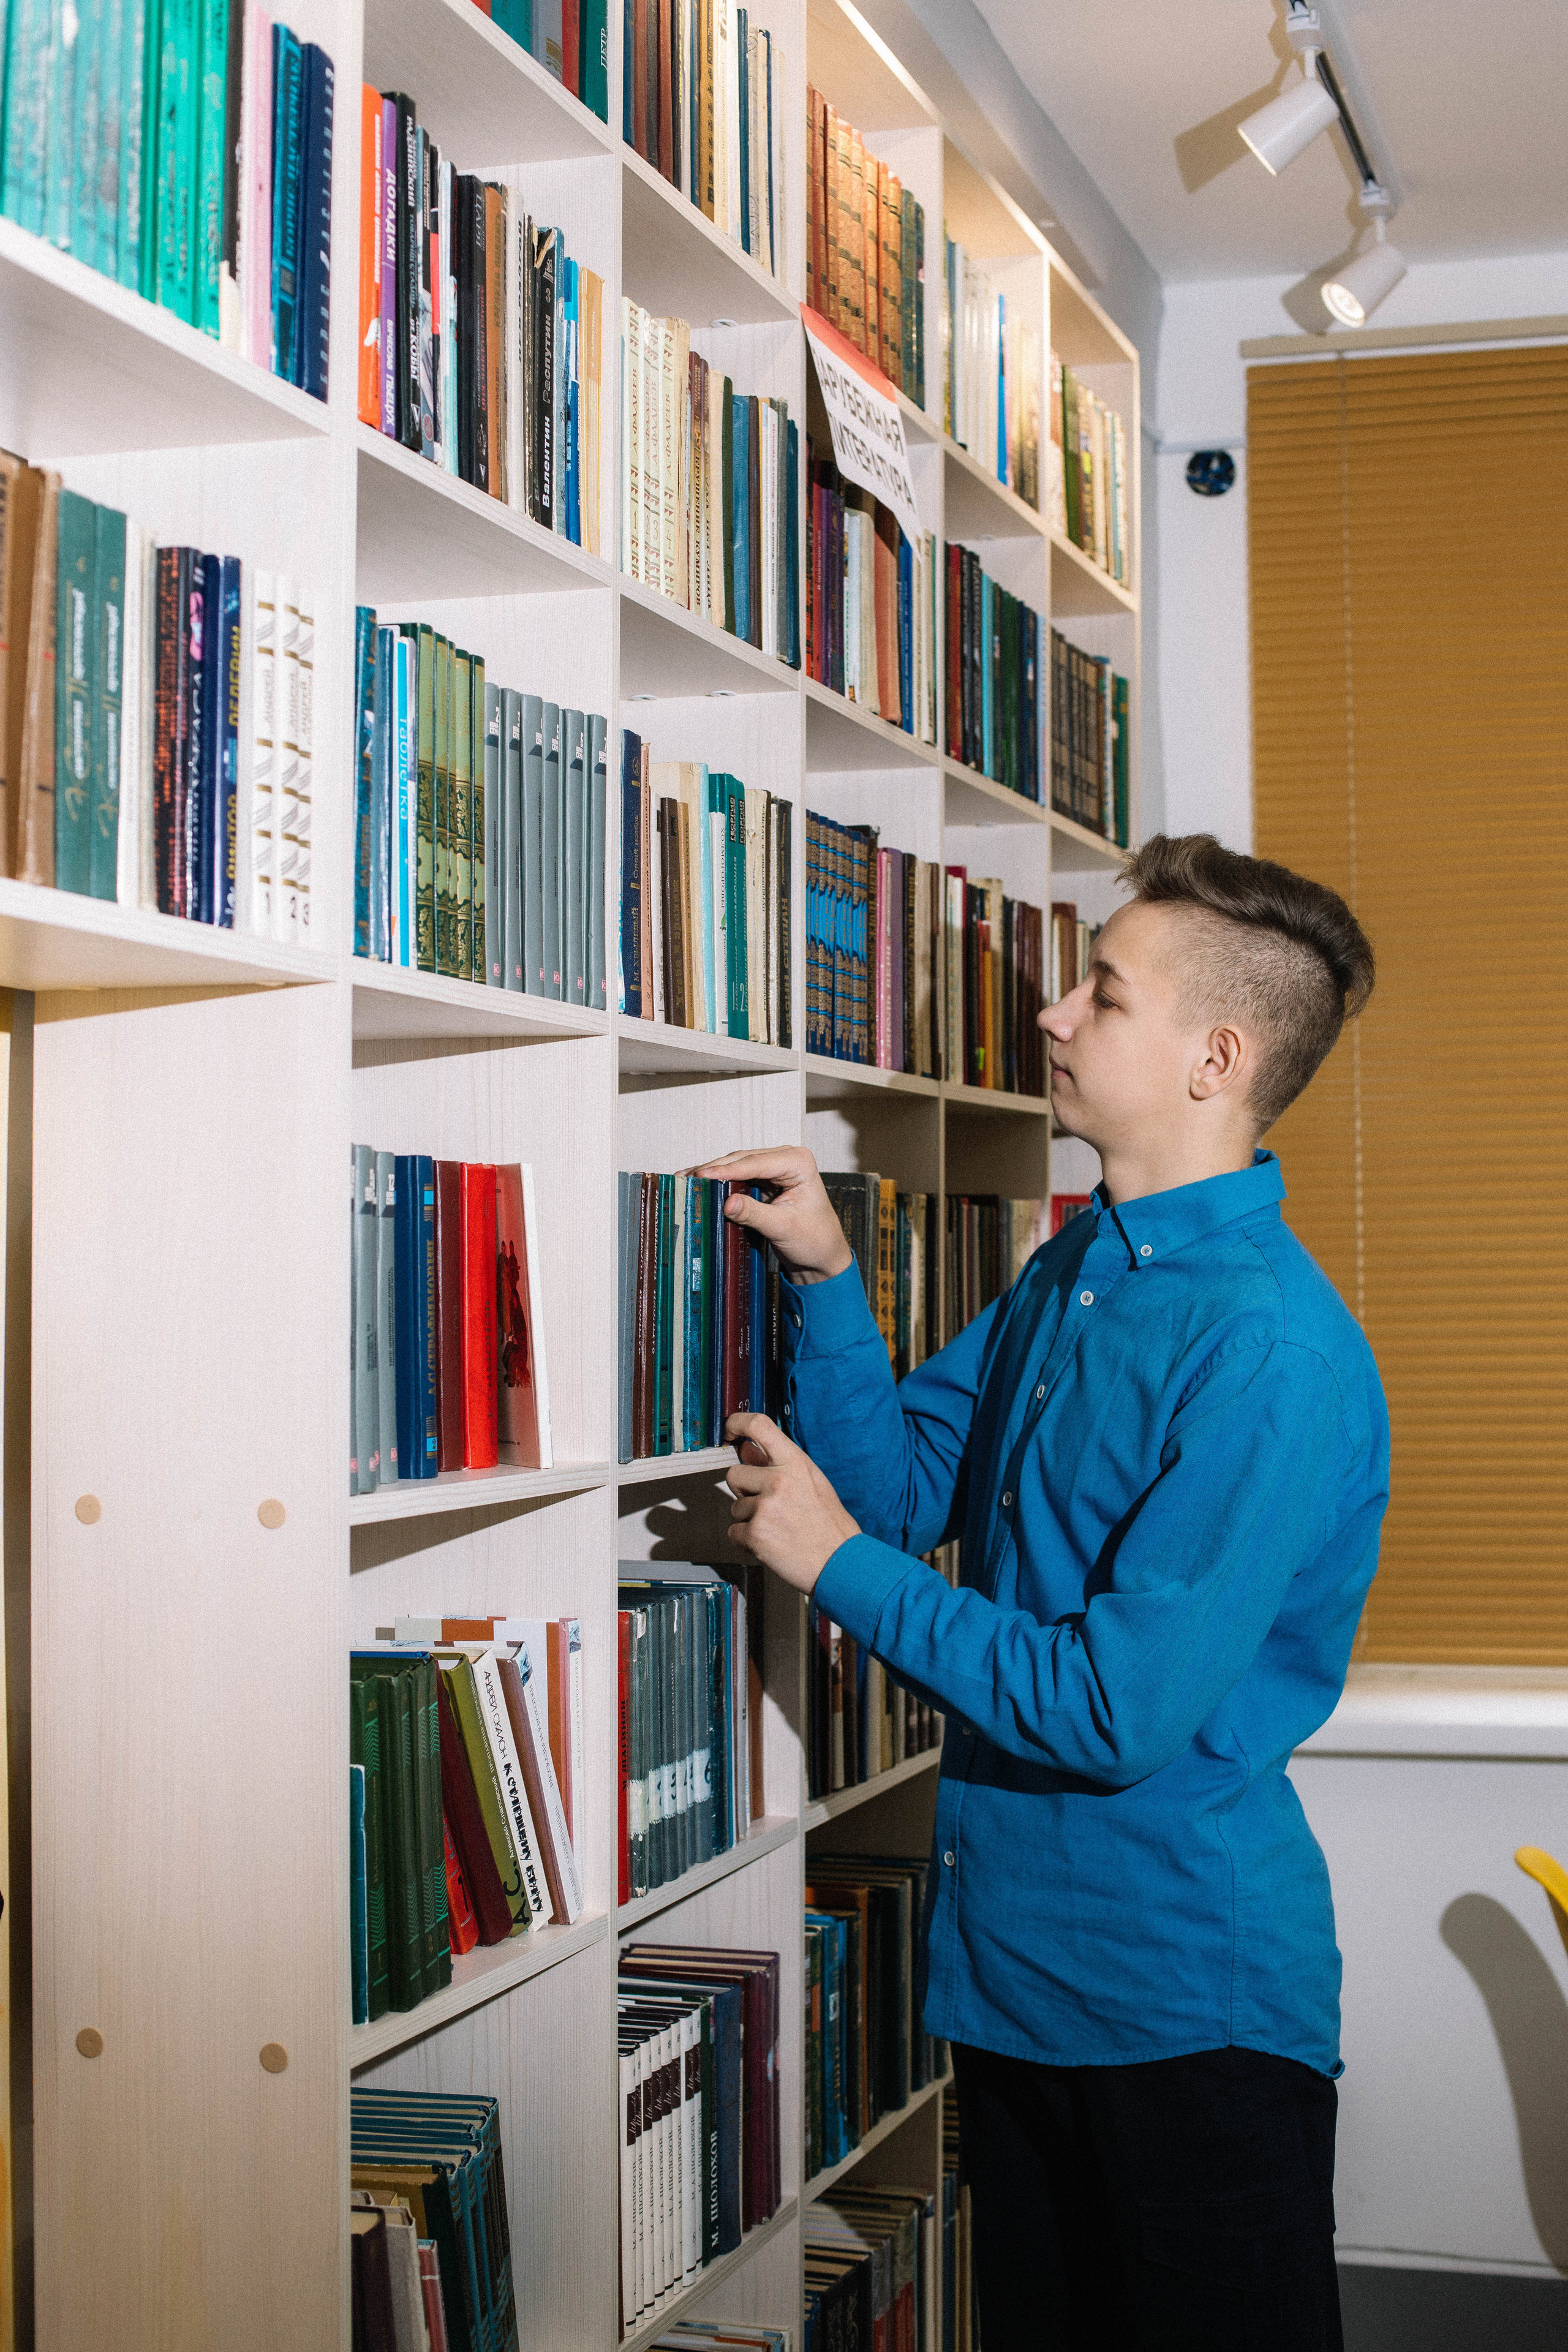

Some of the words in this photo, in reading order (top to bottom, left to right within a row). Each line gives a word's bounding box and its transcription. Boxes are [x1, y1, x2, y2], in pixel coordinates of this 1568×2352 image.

[406, 115, 416, 208] РАДЗИНСКИЙ
[385, 168, 396, 262] ДОГАДКИ
[543, 314, 552, 404] Распутин
[828, 410, 916, 515] ЛИТЕРАТУРА
[634, 510, 637, 529] 1
[653, 519, 658, 540] 3
[666, 529, 672, 549] 4
[290, 896, 297, 919] 2
[303, 903, 309, 925] 3
[631, 907, 639, 968] ХВЫЛЕВЫЙ
[739, 982, 745, 1012] 2
[483, 1671, 497, 1713] АНДРЕЙ
[491, 1713, 509, 1760] СКАЛОН
[481, 1730, 496, 1774] ПРОПАВШИЕ
[503, 1762, 513, 1776] К
[704, 1758, 711, 1785] 6
[529, 1684, 544, 1732] КРОХОТКИ
[540, 1743, 554, 1788] РАССКАЗЫ
[554, 1804, 575, 1864] СОЛЖЕНИЦЫН
[567, 1867, 582, 1911] АЛЕКСАНДР
[492, 1776, 509, 1828] Слаповский
[503, 1829, 515, 1859] Алексей
[506, 1776, 533, 1861] СТАРШЕМУ
[457, 1875, 470, 1913] 1
[502, 1860, 531, 1926] А.С.
[524, 1864, 544, 1913] БРАТУ
[440, 1924, 446, 1941] 4
[669, 2248, 674, 2260] 6
[692, 2231, 696, 2244] 8
[711, 2226, 718, 2248] М.
